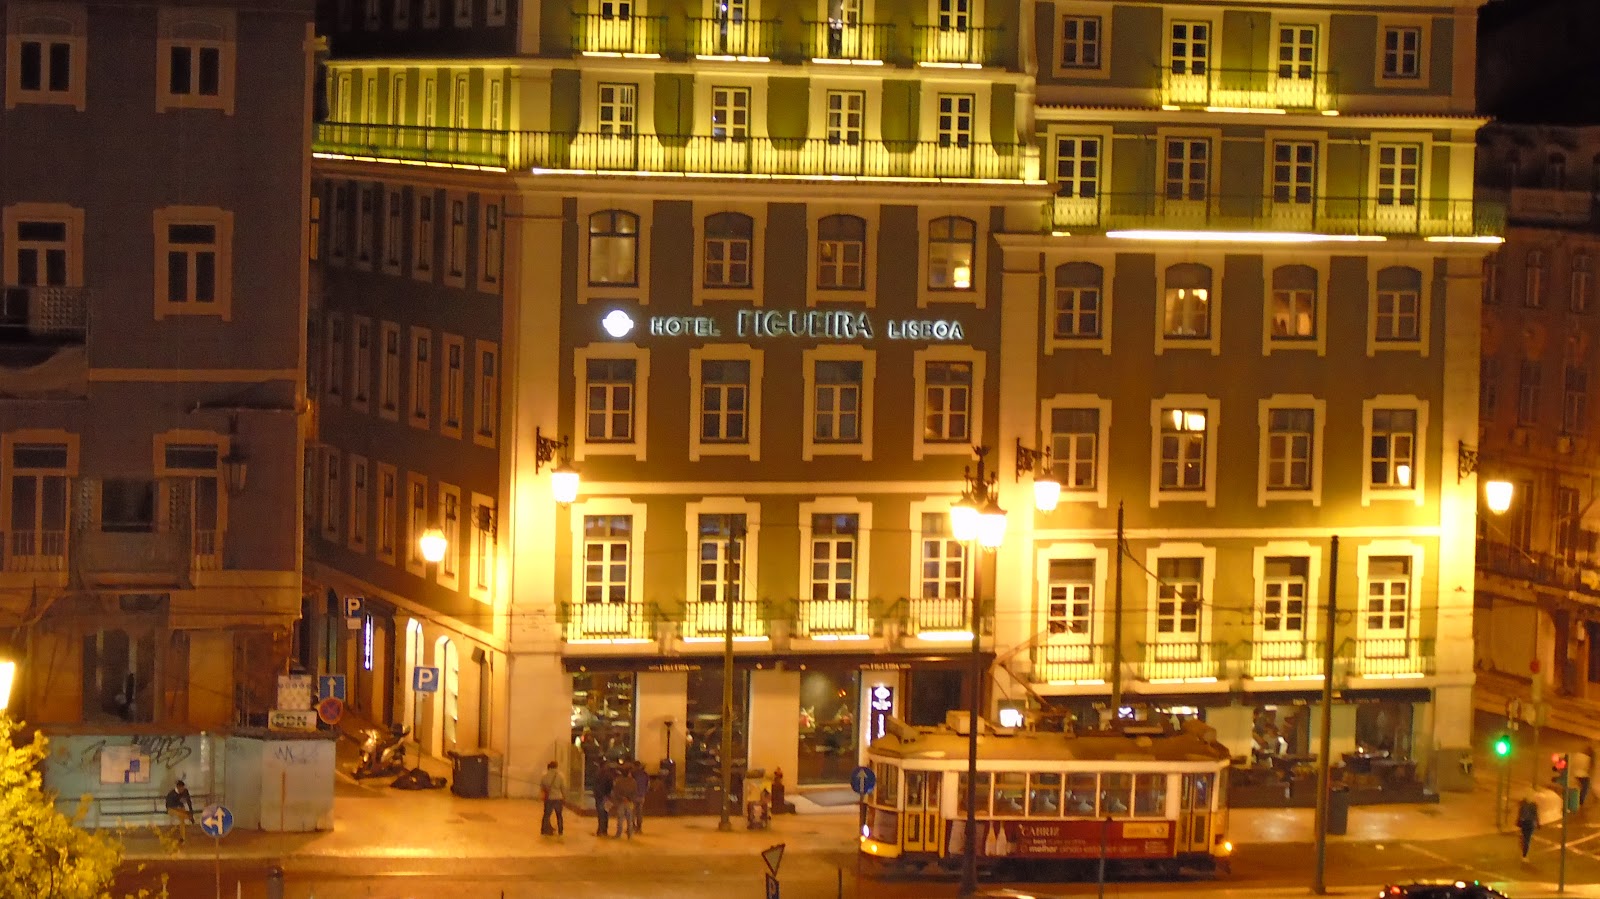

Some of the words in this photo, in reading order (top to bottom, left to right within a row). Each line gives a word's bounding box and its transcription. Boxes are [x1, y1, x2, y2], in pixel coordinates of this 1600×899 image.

[650, 316, 721, 337] HOTEL
[737, 309, 874, 340] FIGUEIRA
[887, 319, 964, 341] LISBOA
[347, 598, 360, 616] P
[418, 669, 432, 689] P
